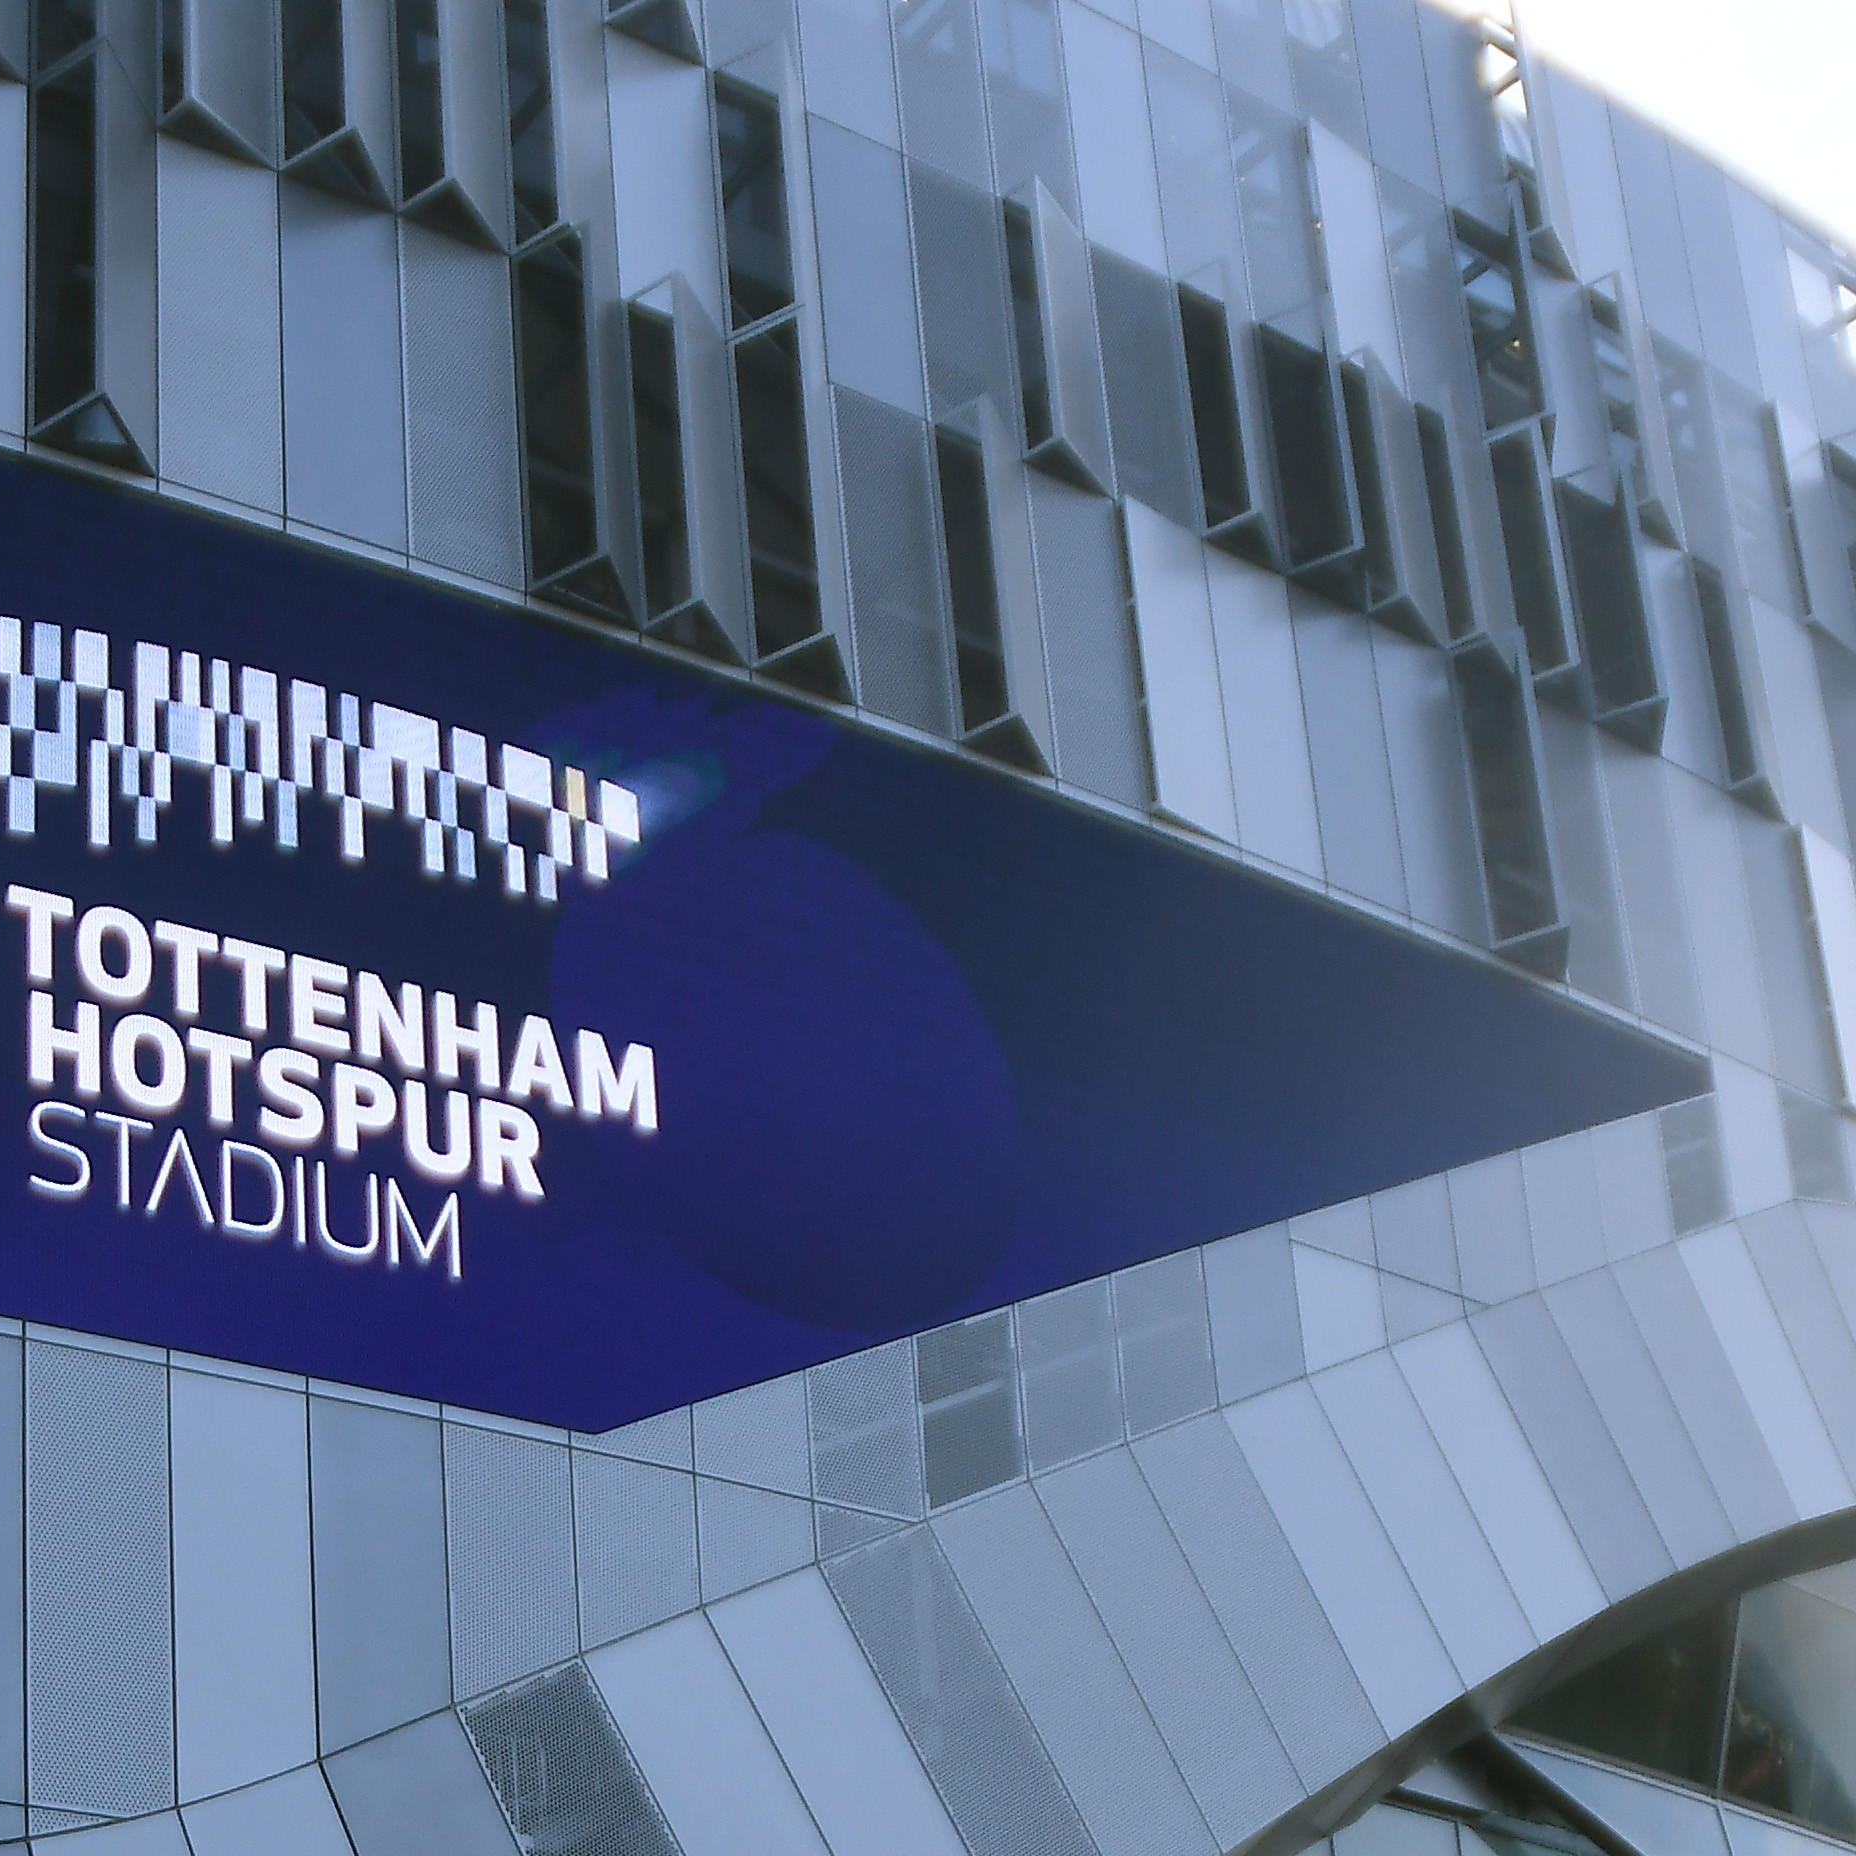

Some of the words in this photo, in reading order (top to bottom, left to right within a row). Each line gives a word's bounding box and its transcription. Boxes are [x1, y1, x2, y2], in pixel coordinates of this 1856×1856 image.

[6, 883, 658, 1131] TOTTENHAM
[27, 989, 545, 1199] HOTSPUR
[29, 1100, 462, 1280] STADIUM
